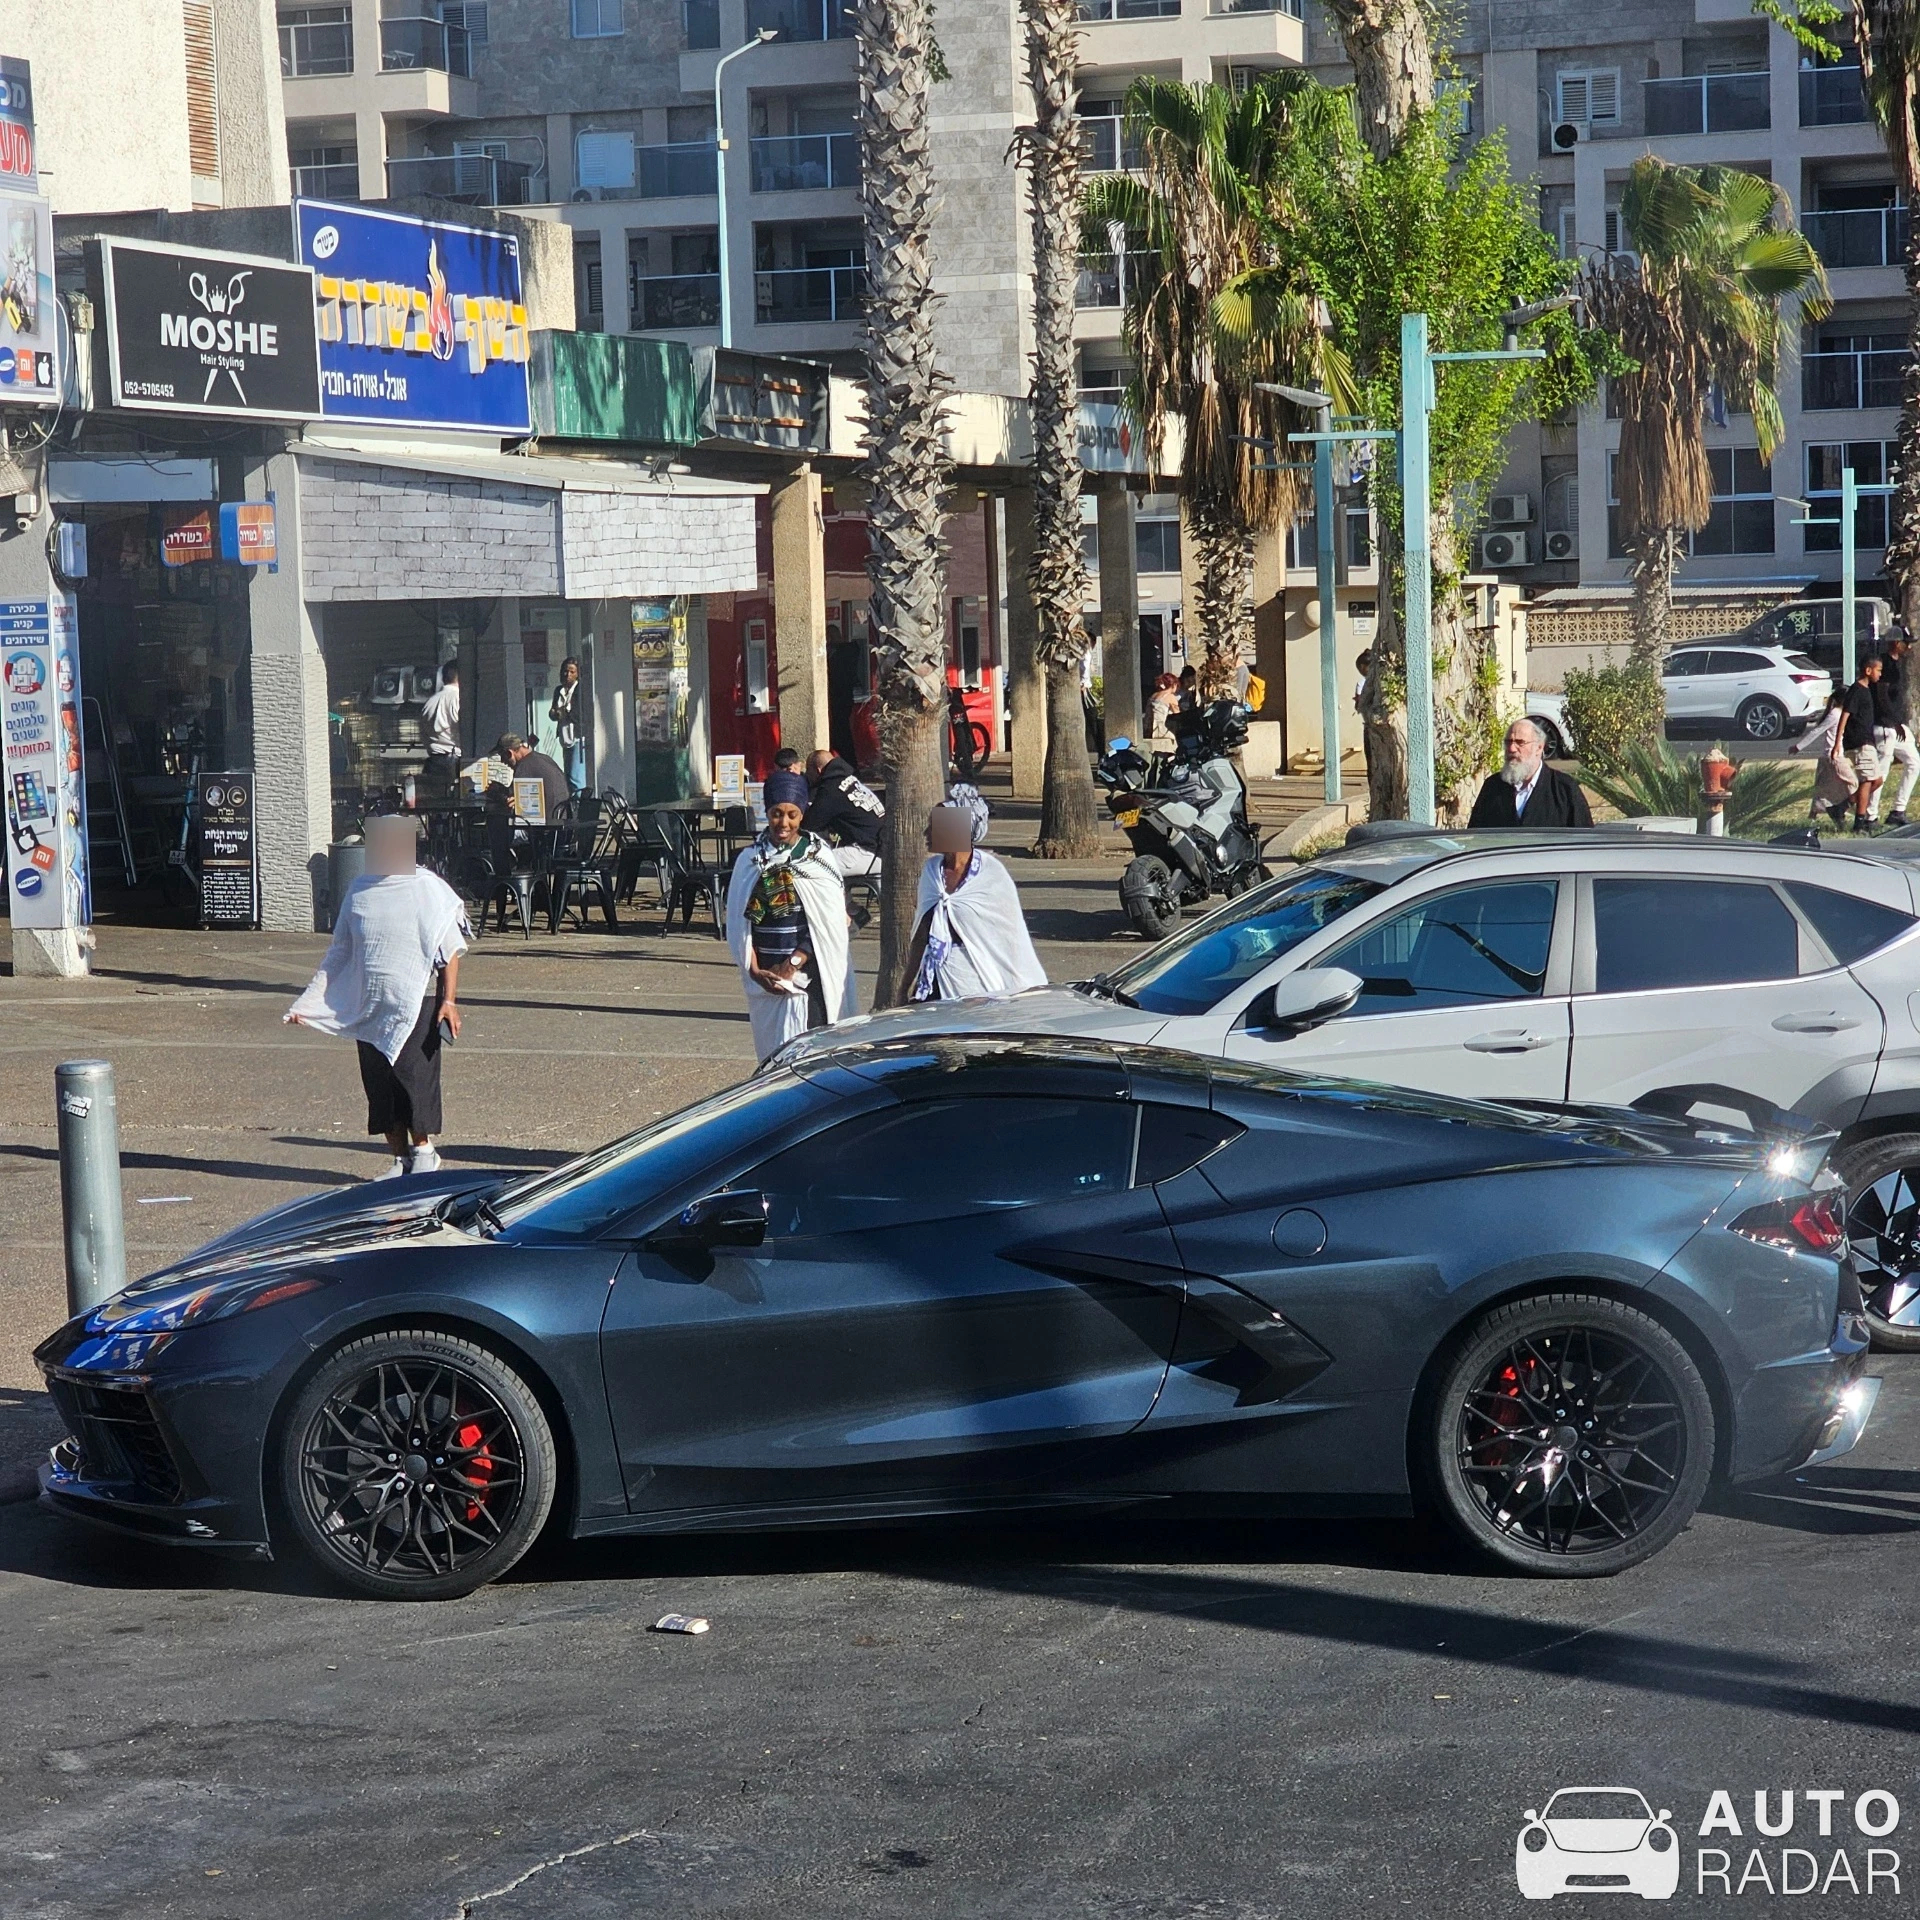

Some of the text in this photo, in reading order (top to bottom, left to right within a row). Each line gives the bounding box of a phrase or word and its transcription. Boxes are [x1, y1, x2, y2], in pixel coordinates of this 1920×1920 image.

[316, 231, 334, 252] כשר
[317, 275, 530, 374] השף בשדרה
[160, 313, 278, 356] MOSHE
[200, 353, 245, 371] Hair Styling
[124, 380, 175, 398] 052-5705452
[321, 369, 407, 400] אוכל אוירה חברי
[166, 531, 203, 545] בשדרה
[9, 605, 36, 614] מכירה
[13, 620, 34, 629] קניה
[5, 635, 45, 645] שידרוגים
[11, 700, 36, 713] קונים
[6, 714, 45, 730] טלפונים
[12, 728, 40, 742] ישנים
[6, 741, 51, 758] במזומן!!!
[213, 840, 238, 856] תפילין
[424, 1344, 474, 1366] MICHELIN
